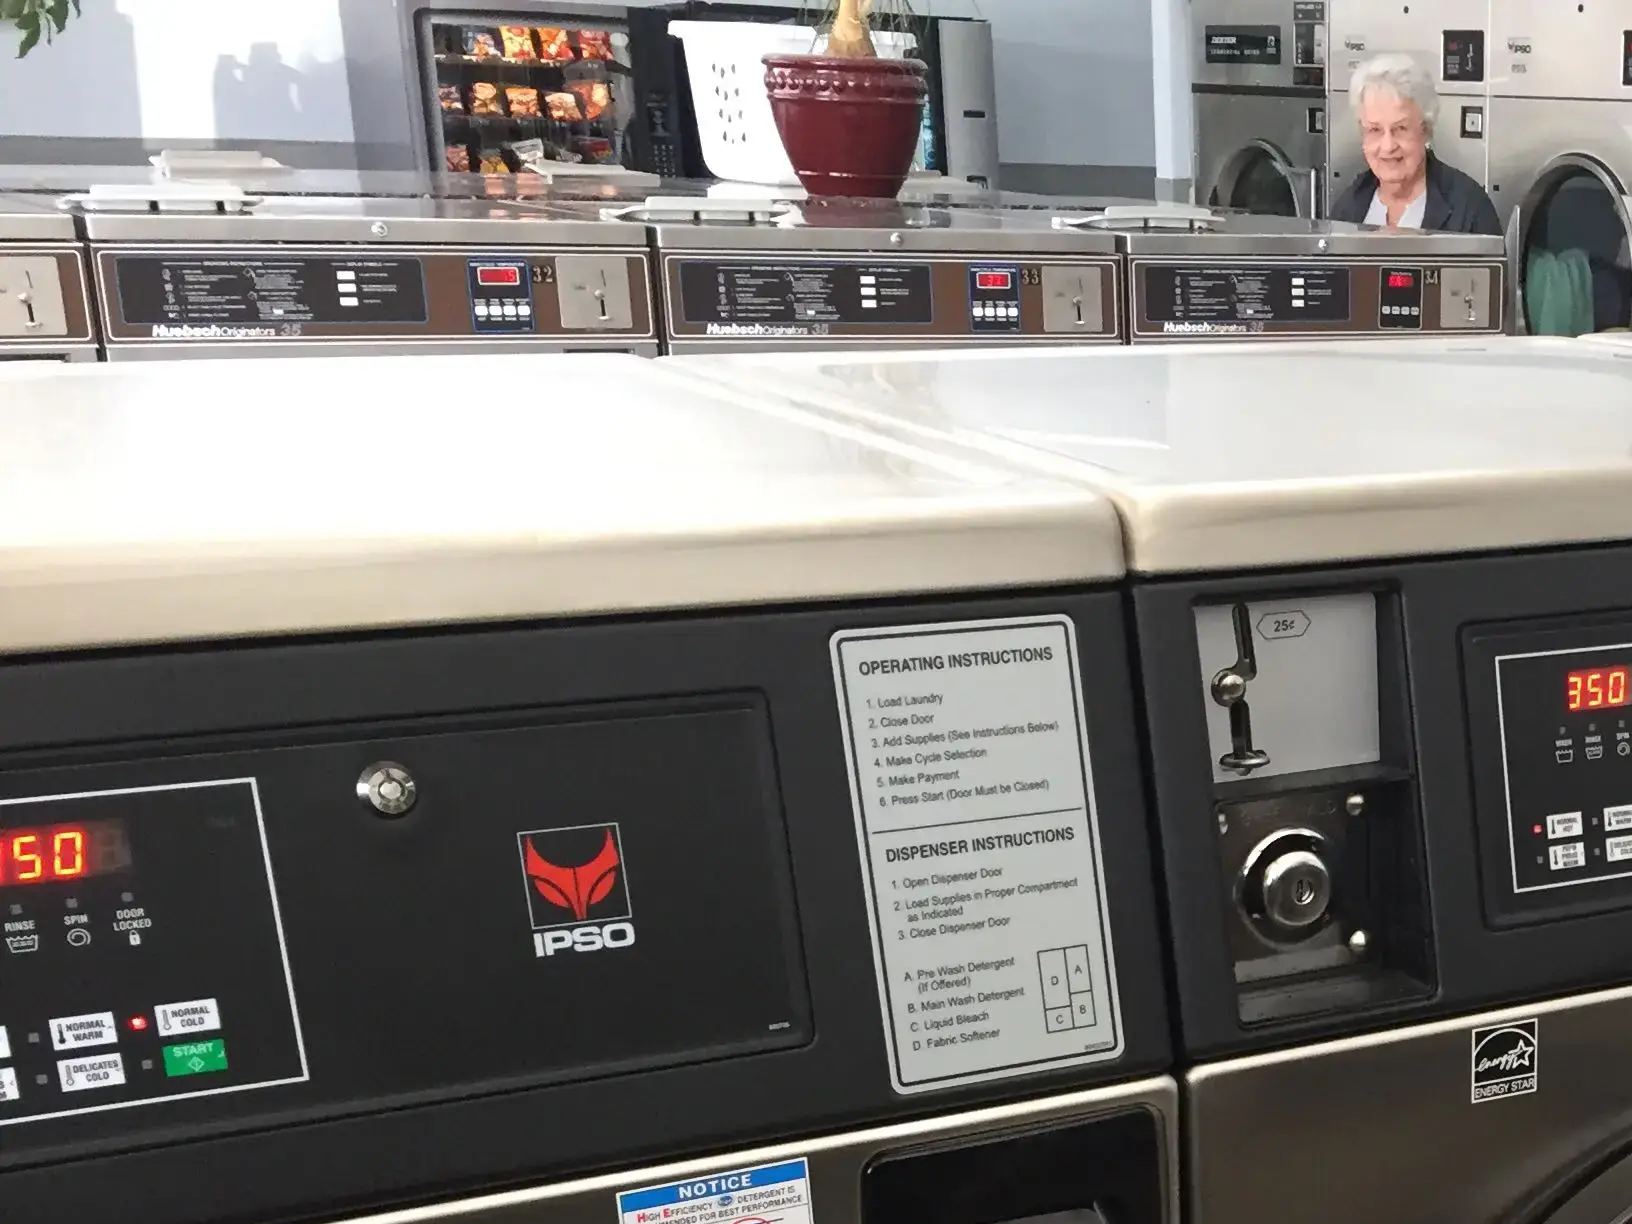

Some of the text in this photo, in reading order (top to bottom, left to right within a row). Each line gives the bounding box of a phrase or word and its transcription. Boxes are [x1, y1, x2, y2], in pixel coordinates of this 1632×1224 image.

[533, 265, 553, 283] 32
[1021, 268, 1041, 285] 33
[1273, 619, 1295, 632] 25¢
[858, 646, 1052, 675] OPERATING INSTRUCTIONS
[1568, 671, 1625, 710] 350
[877, 696, 902, 708] Load
[903, 693, 943, 705] Laundry
[879, 716, 908, 727] Close
[910, 713, 934, 724] Door
[882, 735, 902, 747] Add
[904, 732, 945, 745] Supplies
[947, 729, 970, 742] (See
[972, 724, 1025, 738] Instructions
[885, 755, 912, 766] Make
[914, 752, 941, 765] Cycle
[943, 748, 987, 761] Selection
[888, 769, 959, 786] Make Payment
[891, 794, 919, 805] Press
[921, 791, 944, 802] Start
[945, 788, 972, 801] (Door
[974, 784, 998, 796] Must
[999, 784, 1011, 793] be
[1013, 779, 1049, 791] Closed)
[885, 826, 1074, 862] DISPENSER INSTRUCTIONS
[902, 877, 929, 889] Open
[930, 871, 977, 885] Dispenser
[979, 867, 1002, 878] Door
[905, 897, 929, 909] Load
[931, 892, 972, 906] Supplies
[983, 887, 1015, 898] Proper
[1017, 877, 1078, 894] Compartment
[64, 914, 89, 926] SPIN
[116, 907, 145, 920] DOOR
[907, 905, 963, 922] as Indicated
[4, 920, 36, 932] RINSE
[113, 918, 152, 932] LOCKED
[909, 916, 1010, 938] Close Dispenser Door
[535, 922, 635, 957] IPSO
[916, 969, 935, 979] Pre
[936, 964, 965, 976] Wash
[967, 956, 1015, 972] Detergent
[1074, 964, 1084, 975] A
[917, 975, 970, 993] (If Offered)
[1050, 975, 1059, 986] D
[920, 1000, 945, 1011] Main
[946, 994, 975, 1007] Wash
[977, 986, 1024, 1002] Detergent
[171, 1005, 210, 1018] NORMAL
[1079, 1004, 1088, 1015] B
[65, 1019, 106, 1033] NORMAL
[180, 1015, 206, 1028] COLD
[923, 1016, 953, 1030] Liquid
[955, 1010, 989, 1025] Bleach
[1055, 1015, 1064, 1025] C
[72, 1029, 104, 1042] WARM
[926, 1028, 1000, 1048] Fabric Softener
[172, 1042, 214, 1058] START
[73, 1059, 119, 1074] DELICATES
[85, 1070, 110, 1082] COLD
[1475, 1078, 1534, 1098] ENERGY STAR
[678, 1174, 752, 1199] NOTICE
[737, 1187, 785, 1203] DETERGENT
[637, 1202, 712, 1222] HIGH EFFICIENCY
[698, 1211, 716, 1221] FOR
[718, 1206, 739, 1218] BEST
[741, 1194, 801, 1212] PERFORMANCE
